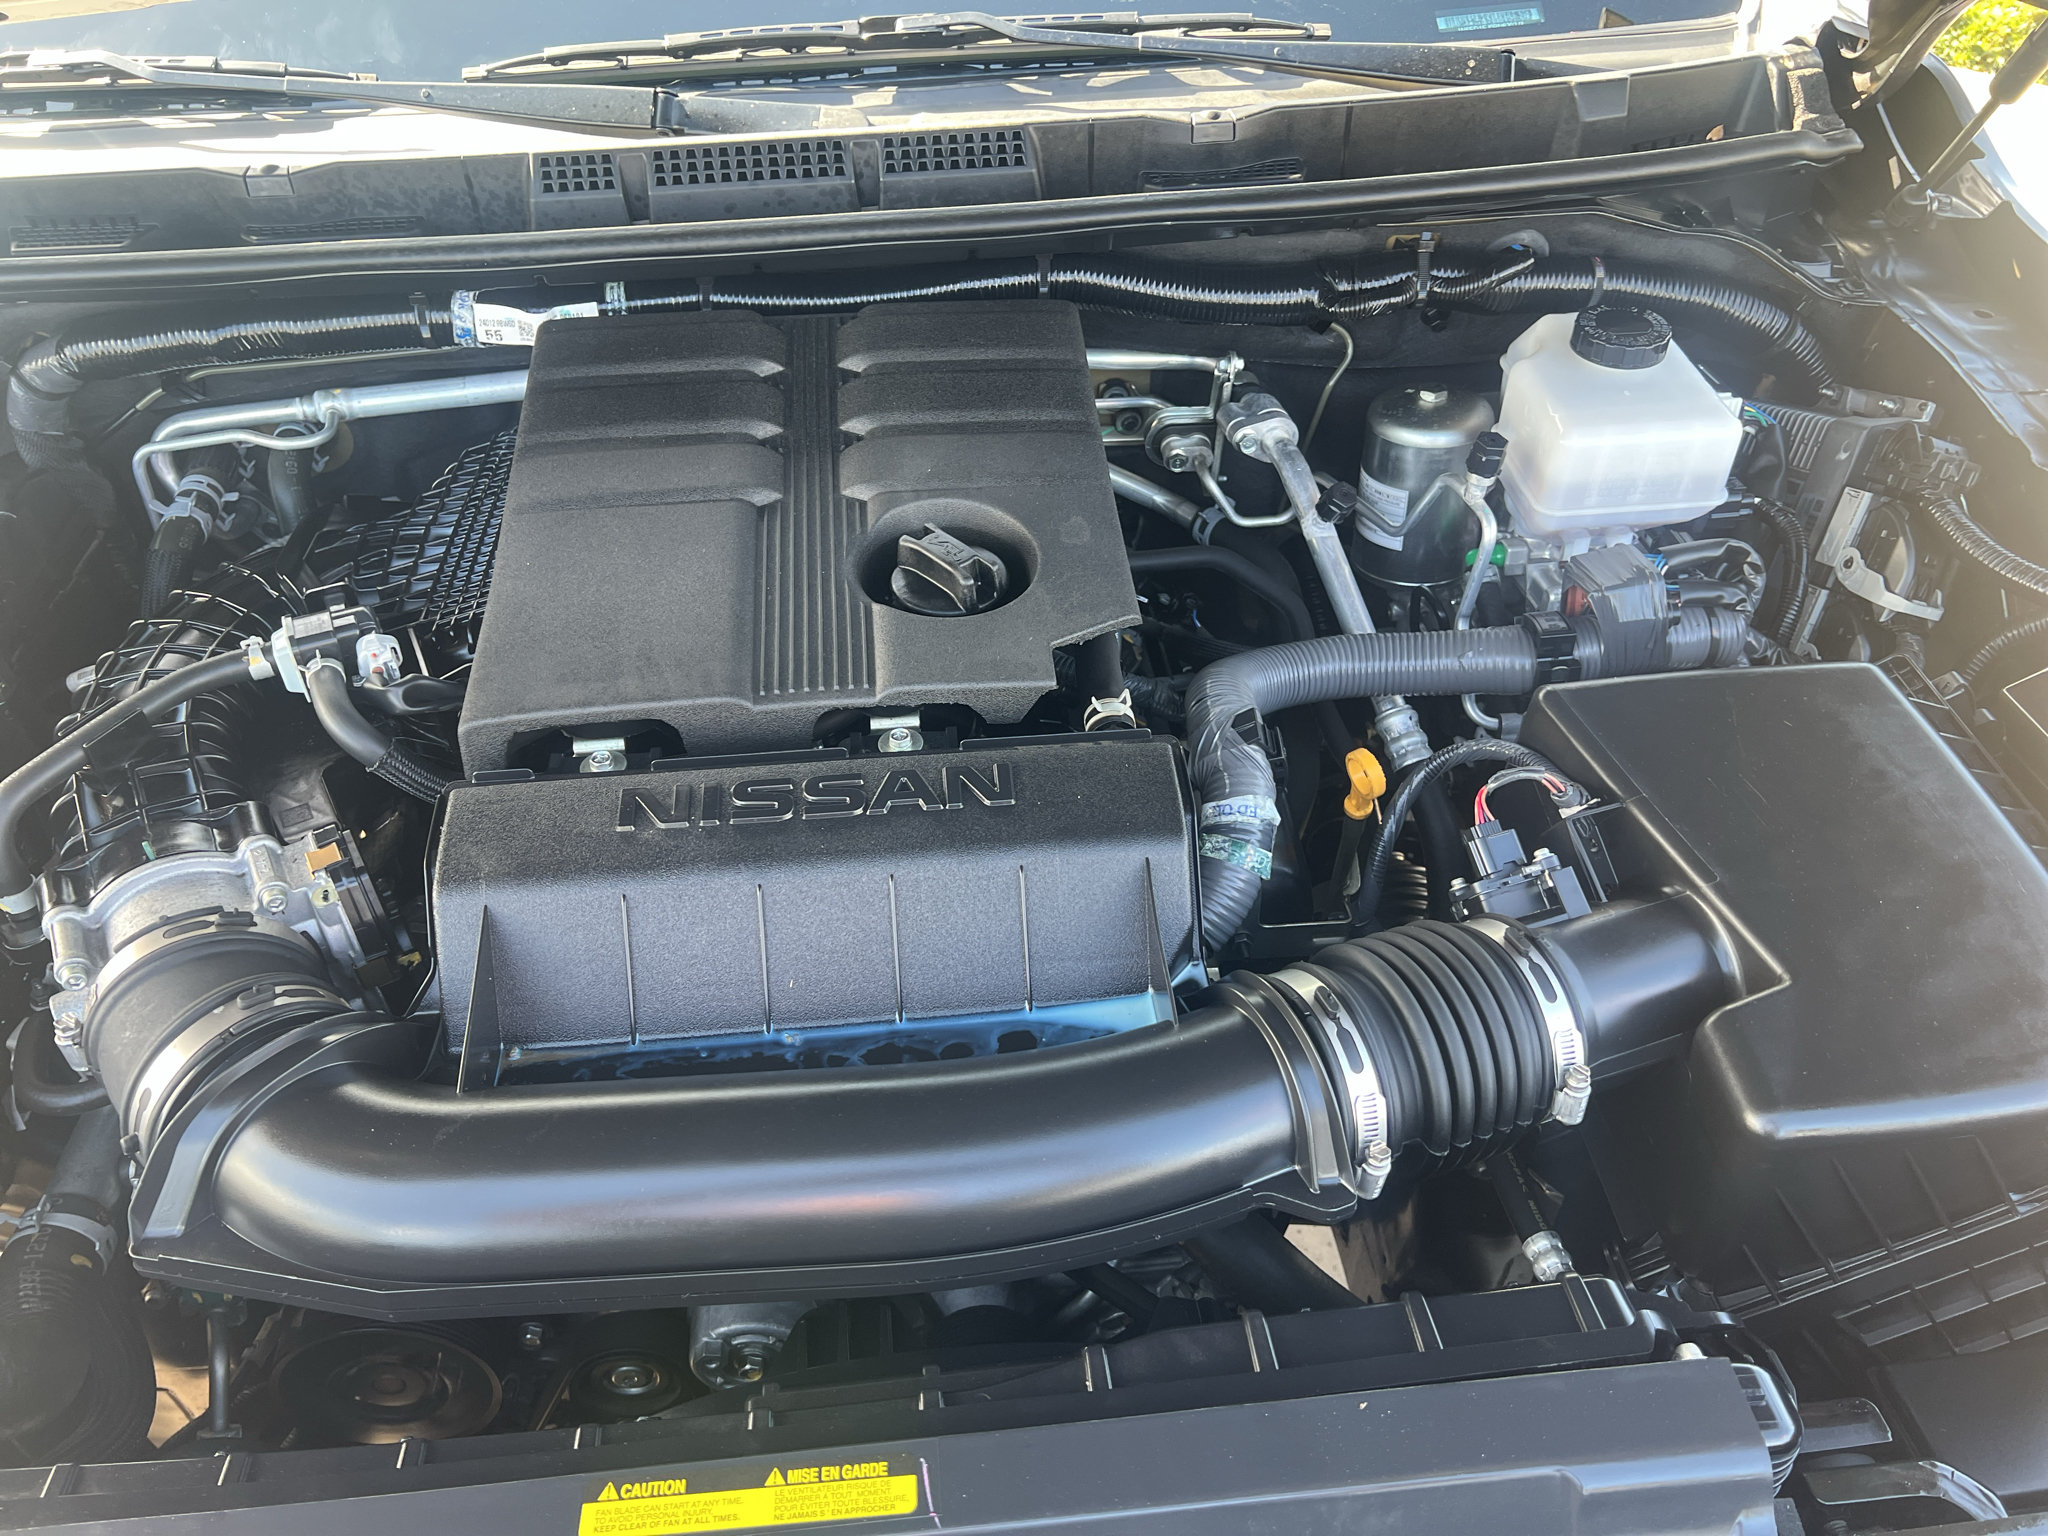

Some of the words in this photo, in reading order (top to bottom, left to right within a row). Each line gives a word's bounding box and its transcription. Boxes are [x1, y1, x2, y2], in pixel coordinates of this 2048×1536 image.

[484, 329, 503, 341] 55
[614, 763, 1016, 831] NISSAN
[787, 1467, 820, 1484] MISE
[821, 1465, 840, 1482] EN
[841, 1461, 888, 1480] GARDE
[620, 1478, 687, 1499] CAUTION
[774, 1488, 785, 1497] LE
[787, 1483, 844, 1496] VENTILATEUR
[846, 1480, 878, 1490] RISQUE
[879, 1479, 892, 1487] DE
[831, 1491, 852, 1499] TOUT
[595, 1509, 612, 1517] FAN
[614, 1505, 641, 1516] BLADE
[643, 1504, 661, 1513] CAN
[663, 1502, 690, 1511] START
[691, 1500, 702, 1508] AT
[702, 1499, 720, 1508] ANY
[773, 1512, 785, 1521] NE
[786, 1510, 818, 1520] JAMAIS
[844, 1504, 896, 1515] APPROCHER
[774, 1504, 798, 1513] POUR
[832, 1498, 860, 1507] TOUTE
[594, 1524, 617, 1534] KEEP
[618, 1521, 647, 1531] CLEAR
[649, 1520, 662, 1529] OF
[663, 1519, 680, 1528] FAN
[681, 1517, 693, 1526] AT
[694, 1516, 711, 1524] ALL
[595, 1516, 607, 1525] TO
[608, 1514, 633, 1524] AVOID
[635, 1511, 680, 1522] PERSONAL
